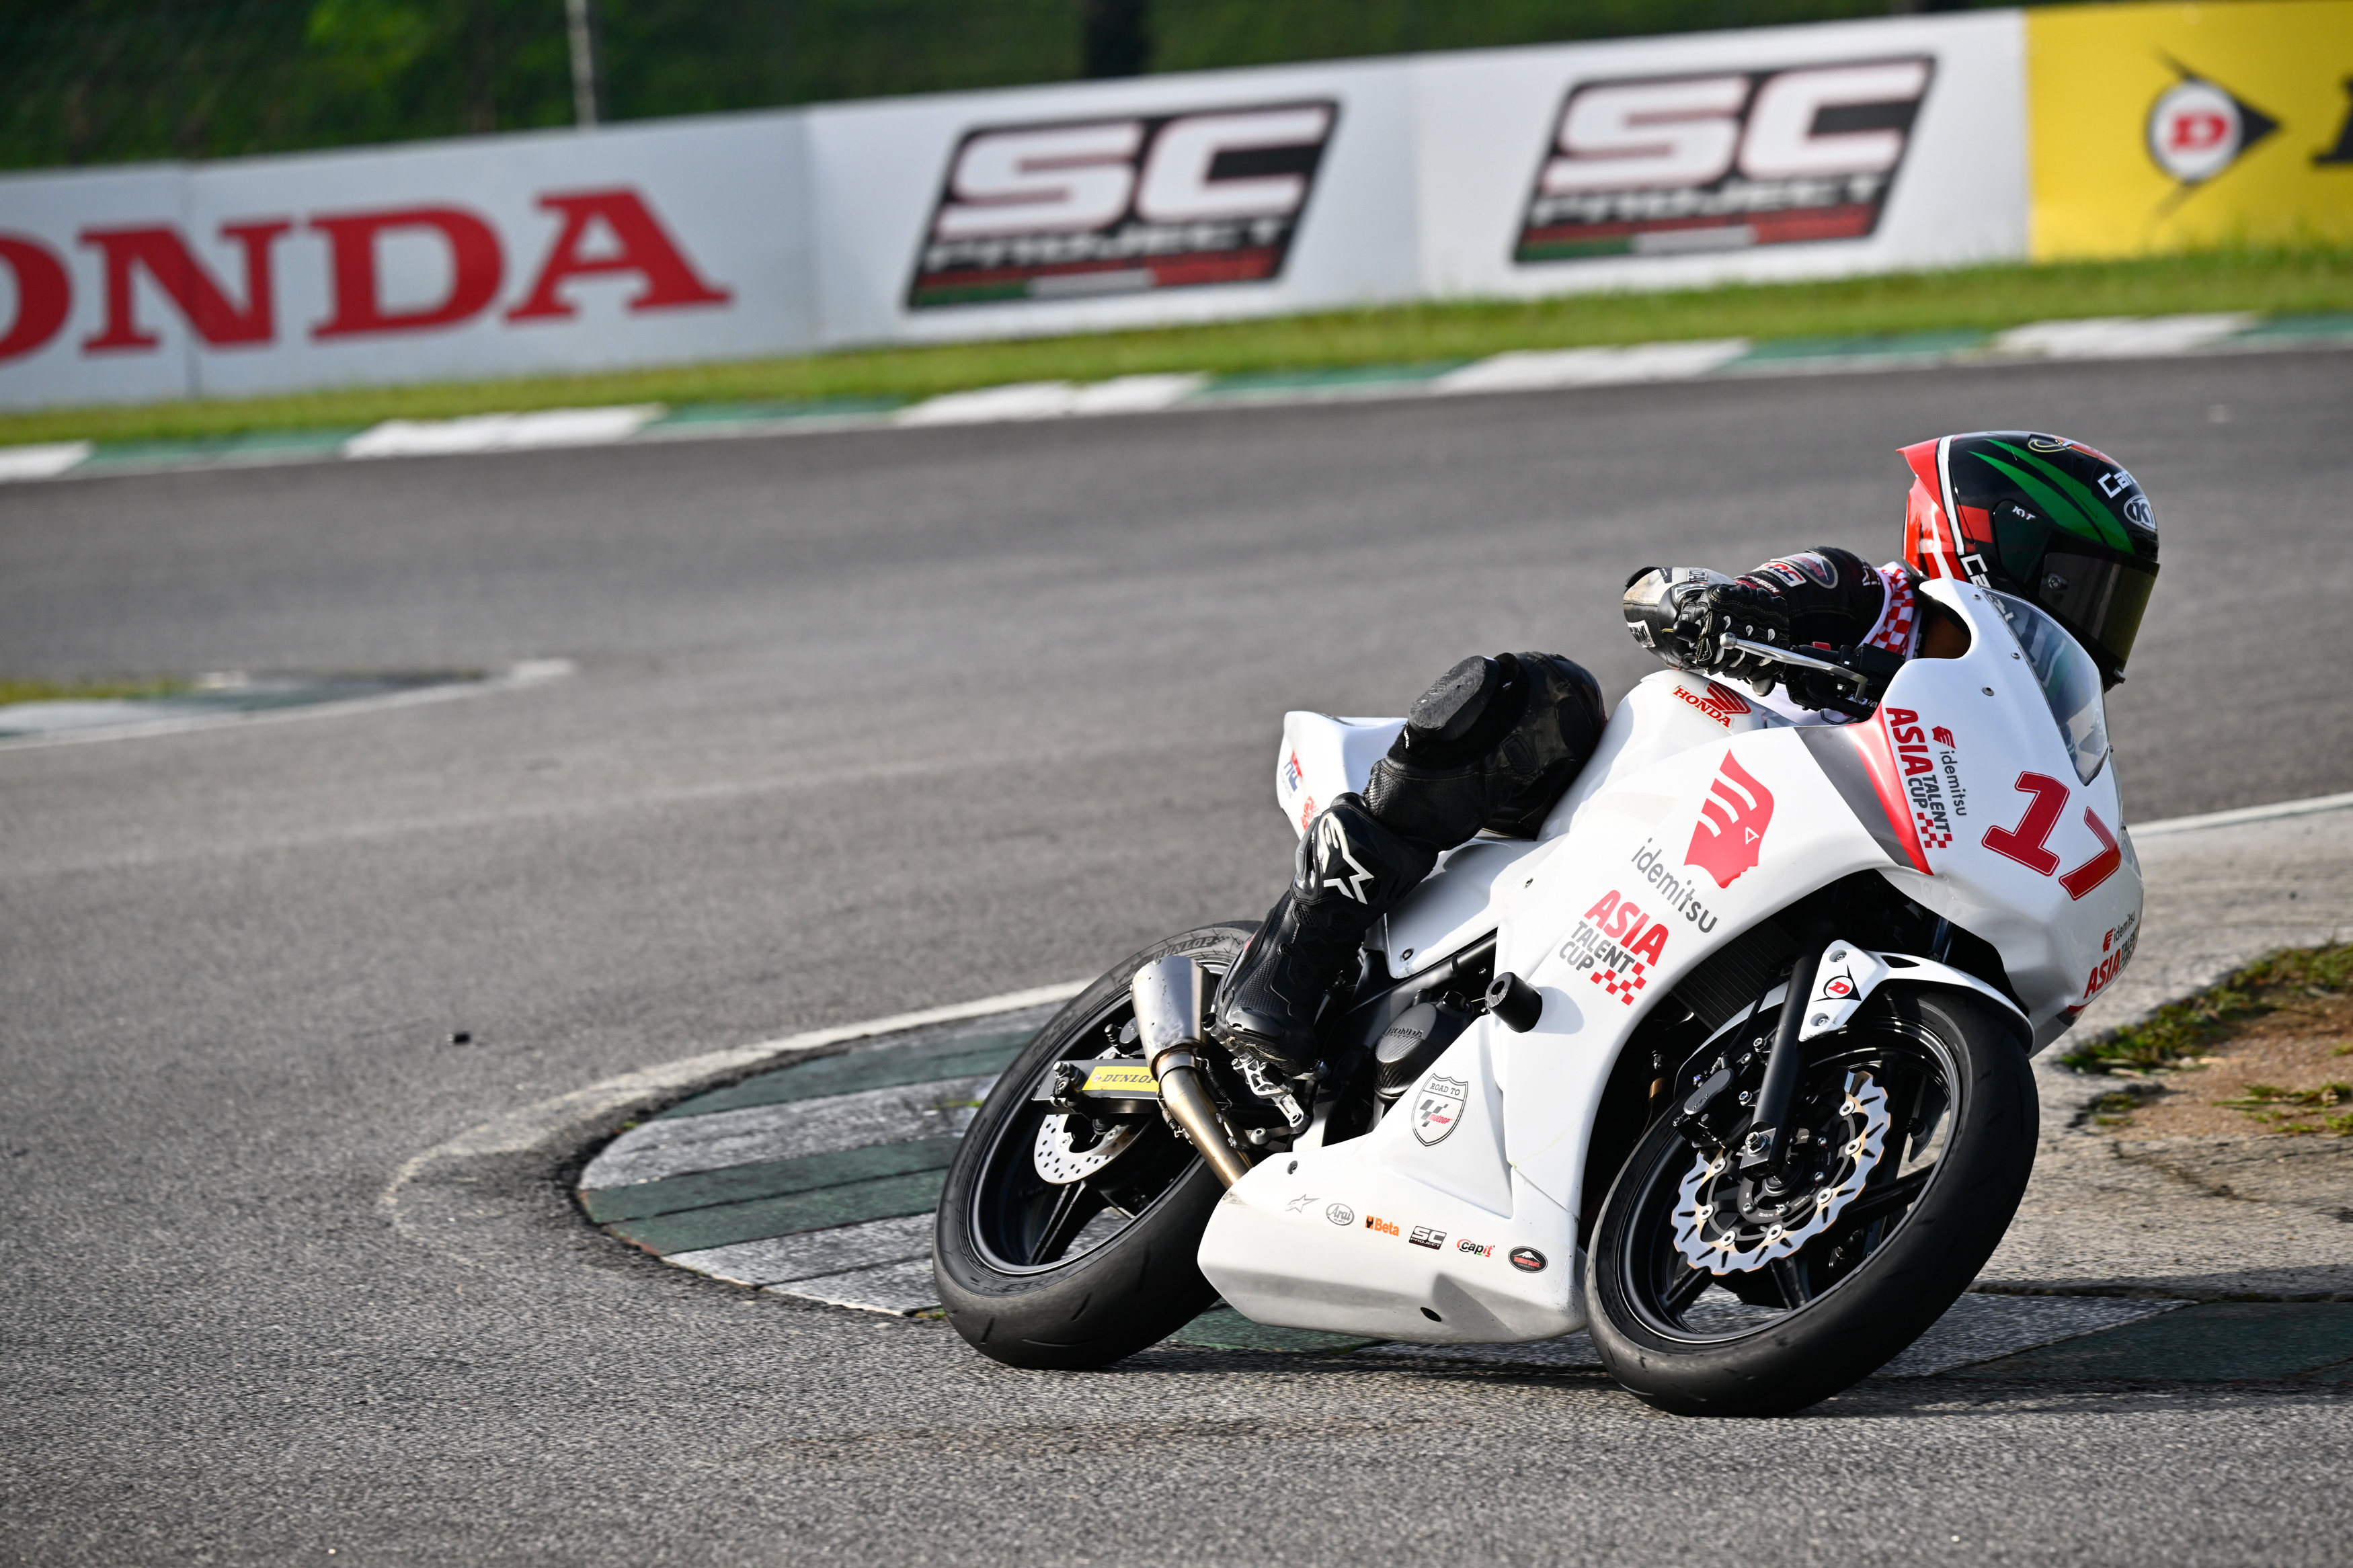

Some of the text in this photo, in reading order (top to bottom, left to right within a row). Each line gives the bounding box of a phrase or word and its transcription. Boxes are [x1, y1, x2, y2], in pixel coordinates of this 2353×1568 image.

[1544, 61, 1931, 193] SC
[936, 107, 1330, 243] SC
[1532, 173, 1882, 226] PROJECT
[925, 219, 1289, 272] PROJECT
[2011, 505, 2036, 520] KYT
[1673, 688, 1732, 728] HONDA
[1885, 708, 1933, 776] ASIA
[1908, 778, 1928, 809] CUP
[1922, 774, 1951, 833] TALENT
[1940, 750, 1967, 816] idemitsu
[1981, 771, 2122, 901] 17
[1631, 837, 1718, 933] idemitsu
[1570, 920, 1636, 974] TALENT
[1583, 889, 1669, 967] ASIA
[2114, 911, 2135, 943] idemitsu
[1559, 941, 1595, 971] CUP
[2083, 948, 2120, 999] ASIA
[1430, 1083, 1461, 1096] ROAD TO
[1328, 1205, 1351, 1221] Arai
[1374, 1217, 1400, 1236] Beta
[1412, 1227, 1445, 1244] SC
[1410, 1237, 1441, 1248] PROJECT
